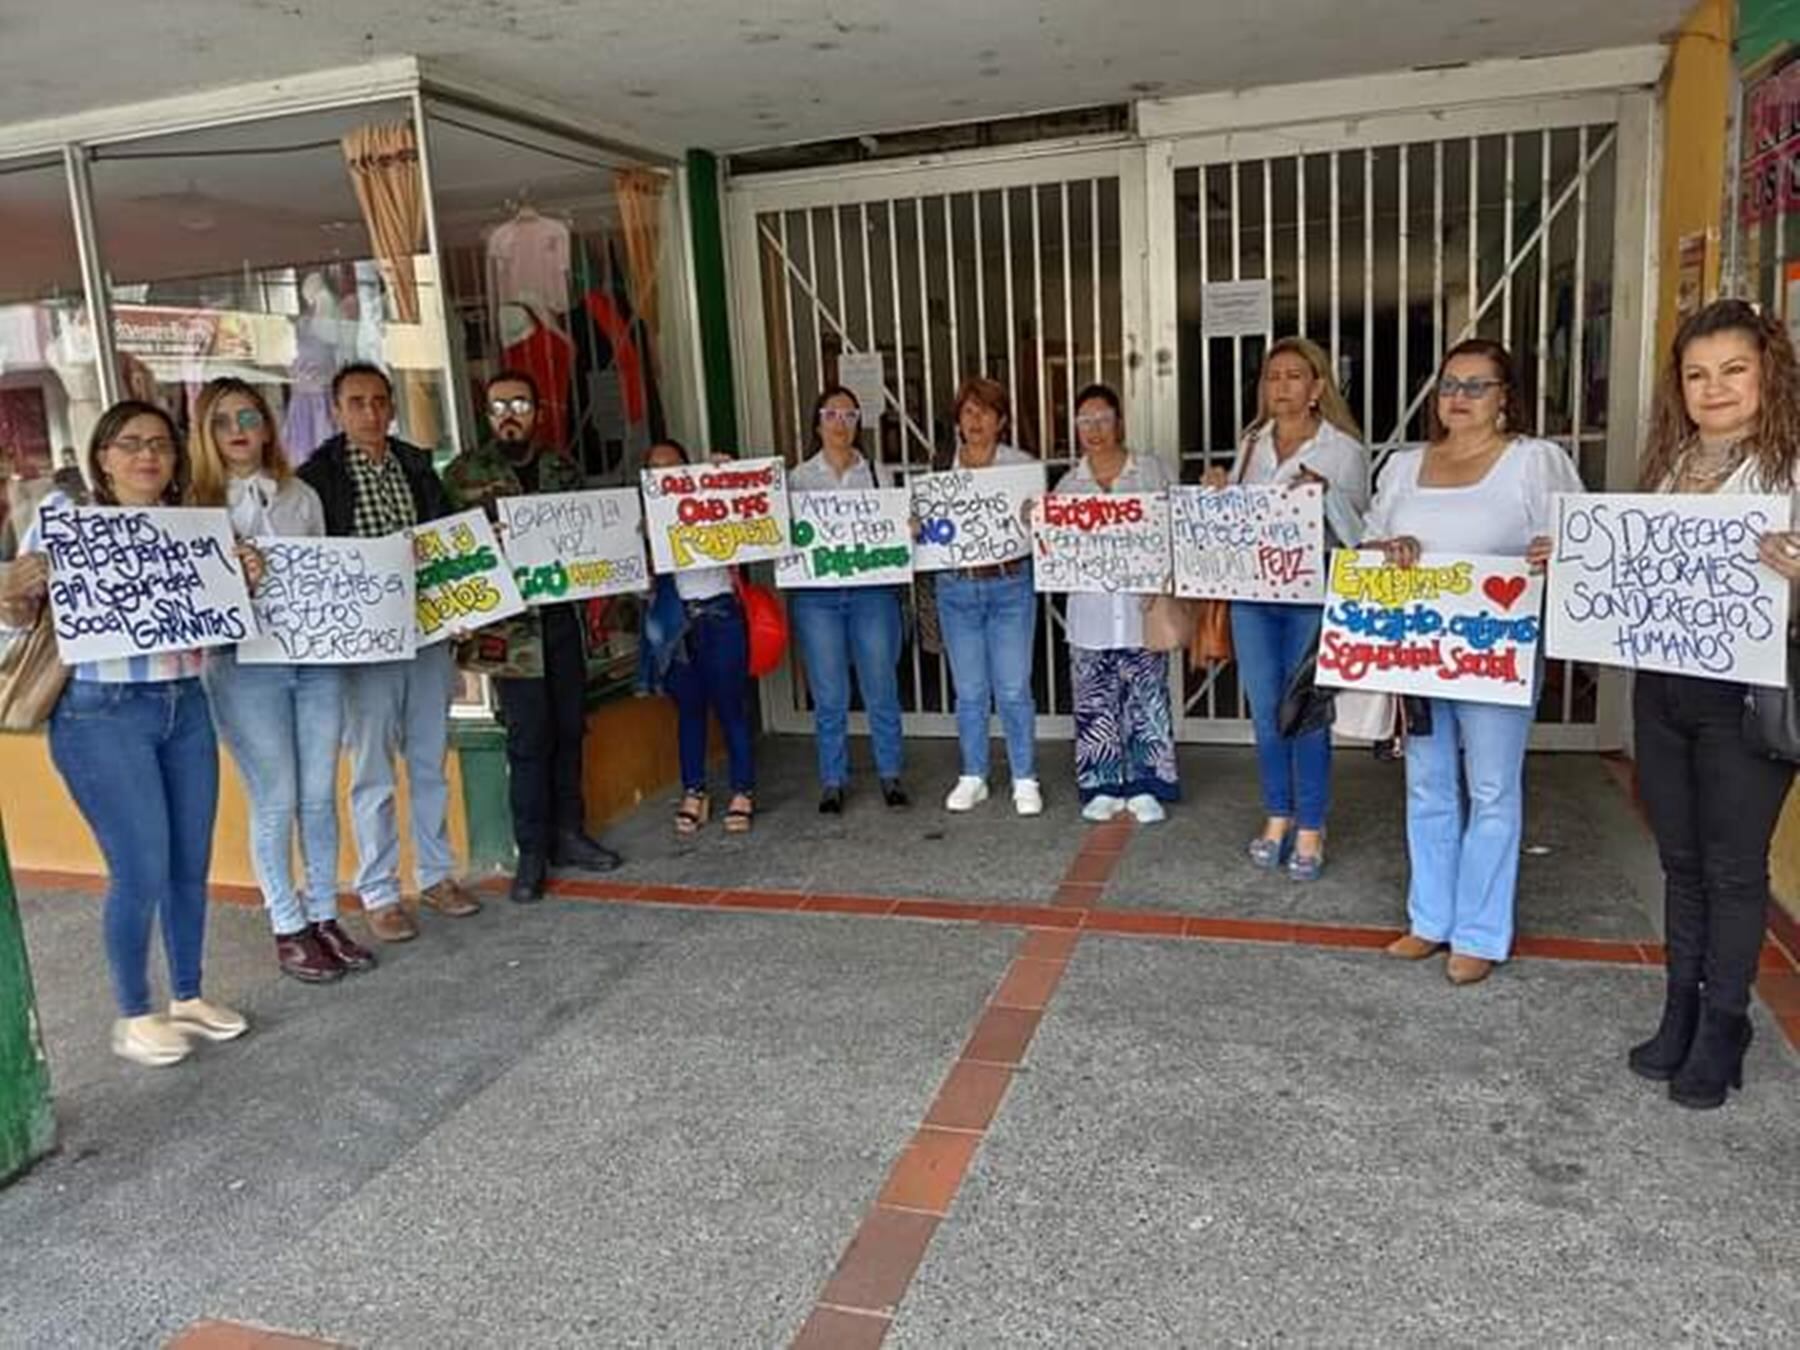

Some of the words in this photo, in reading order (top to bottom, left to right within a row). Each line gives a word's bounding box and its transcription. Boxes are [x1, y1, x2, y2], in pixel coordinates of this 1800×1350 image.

[39, 506, 160, 545] Estamos
[1557, 497, 1616, 572] LOS
[1616, 509, 1768, 562] DERECHOS
[1611, 545, 1761, 598] LABORALES
[1612, 624, 1736, 674] HUMANOS
